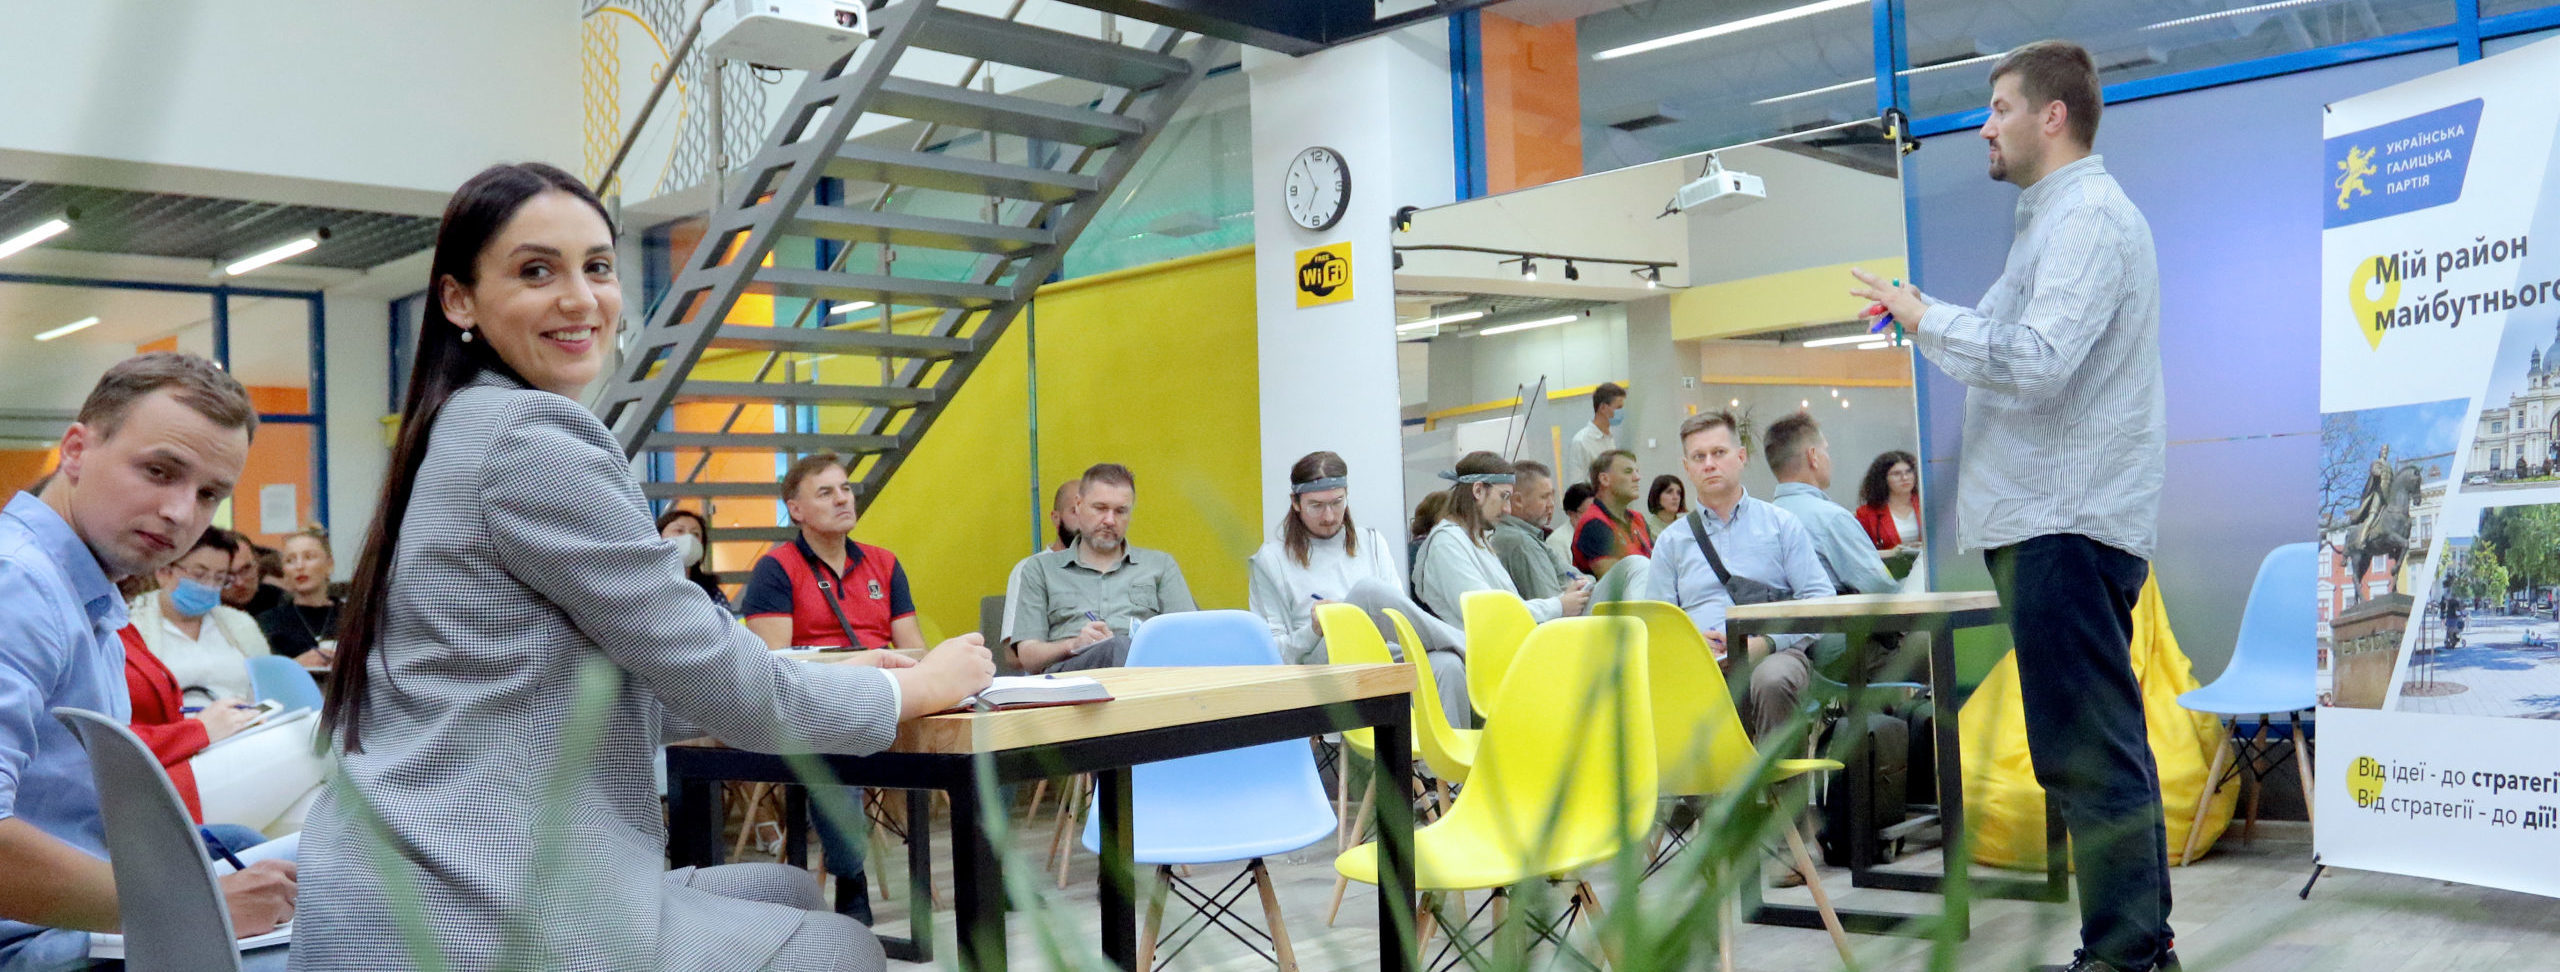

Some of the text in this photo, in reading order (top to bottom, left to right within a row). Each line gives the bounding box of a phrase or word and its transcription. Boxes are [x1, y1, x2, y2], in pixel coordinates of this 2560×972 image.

[2386, 124, 2465, 155] УКРАЇНСЬКА
[1311, 151, 1323, 162] 12
[2387, 148, 2452, 175] ГАЛИЦЬКА
[1290, 185, 1298, 196] 9
[2387, 174, 2430, 195] ПАРТІЯ
[1312, 215, 1321, 226] 6
[2375, 235, 2528, 284] Мій район
[2358, 757, 2387, 781] Від
[2392, 759, 2426, 787] ідеї
[2441, 769, 2466, 788] до
[2472, 771, 2560, 795] стратегі
[2357, 788, 2386, 814] Від
[2391, 797, 2474, 820] стратегії
[2491, 808, 2517, 828] до
[2523, 805, 2557, 830] дії!
